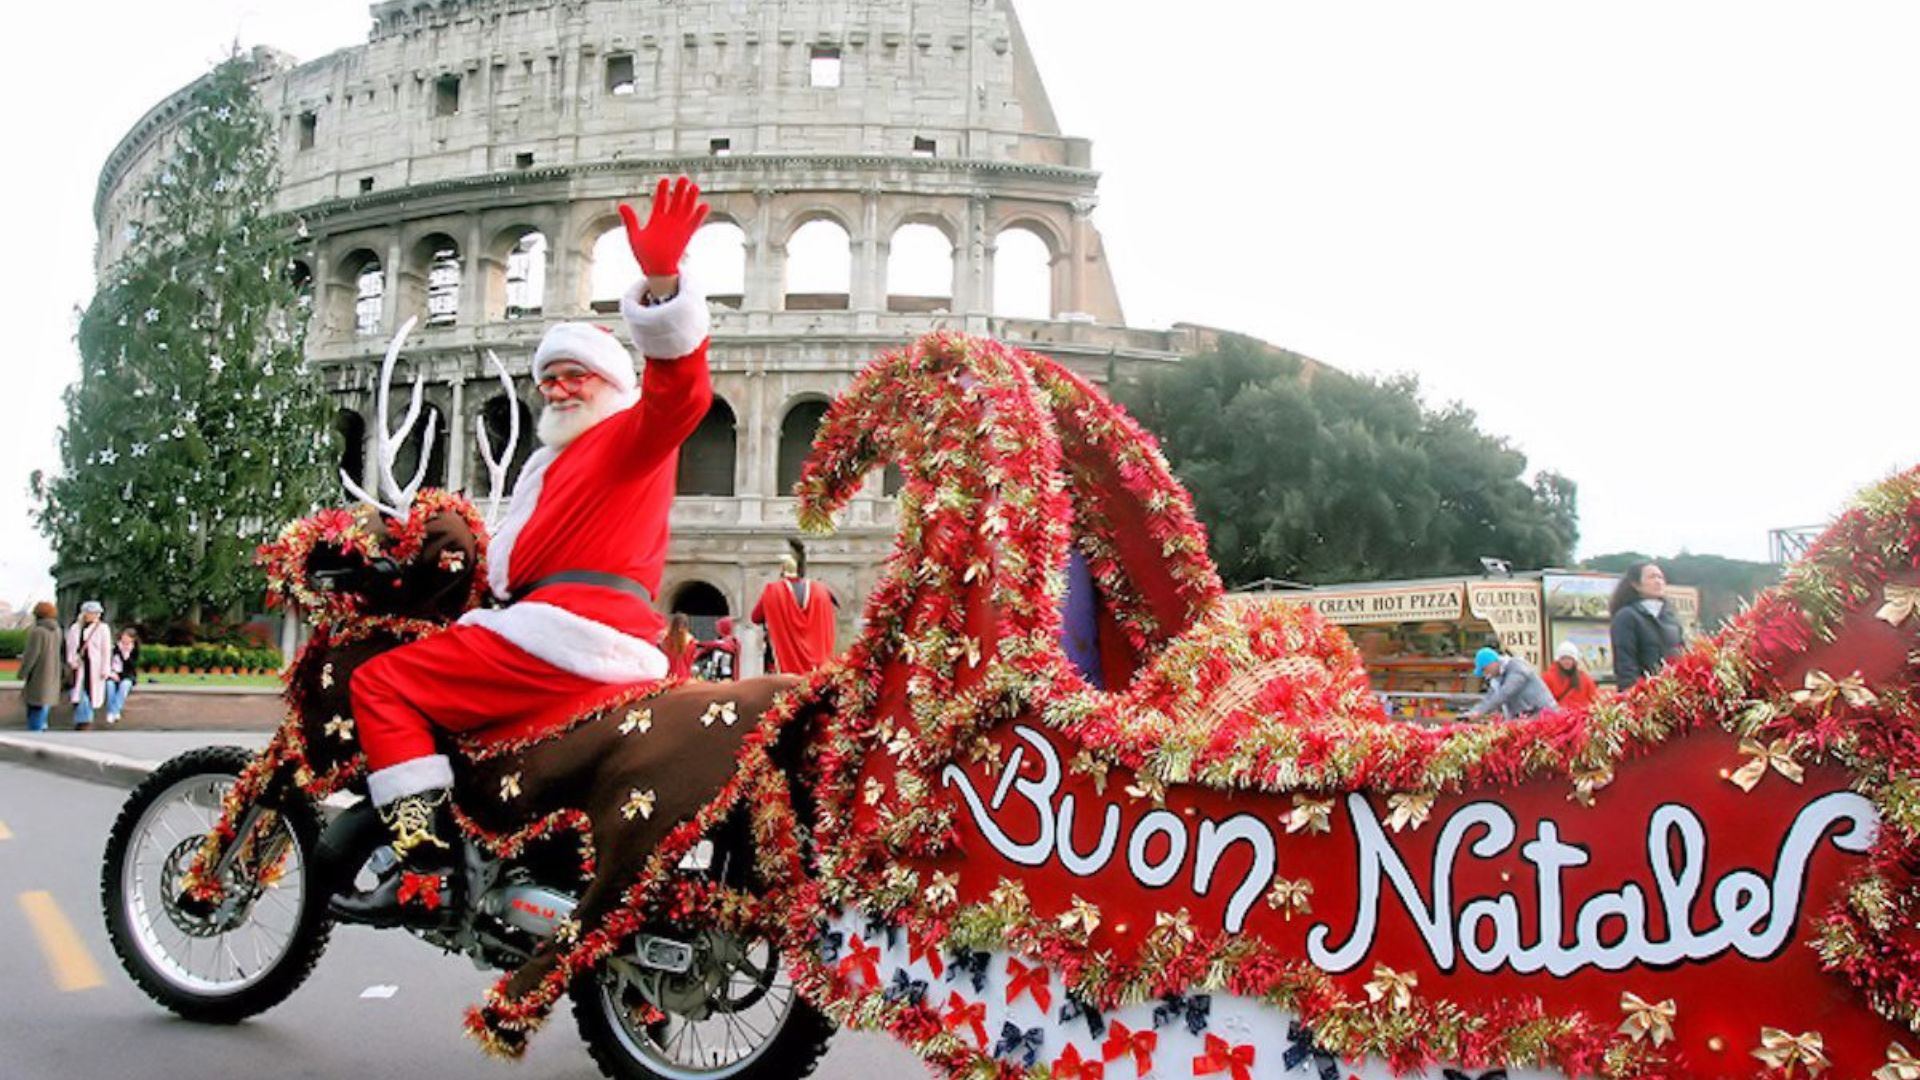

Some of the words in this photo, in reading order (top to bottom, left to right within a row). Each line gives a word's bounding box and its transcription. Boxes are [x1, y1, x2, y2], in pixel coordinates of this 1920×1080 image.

[1319, 598, 1365, 614] CREAM
[1373, 596, 1404, 611] HOT
[1410, 592, 1458, 609] PIZZA
[942, 724, 1277, 934] Buon
[1306, 792, 1877, 977] Natale
